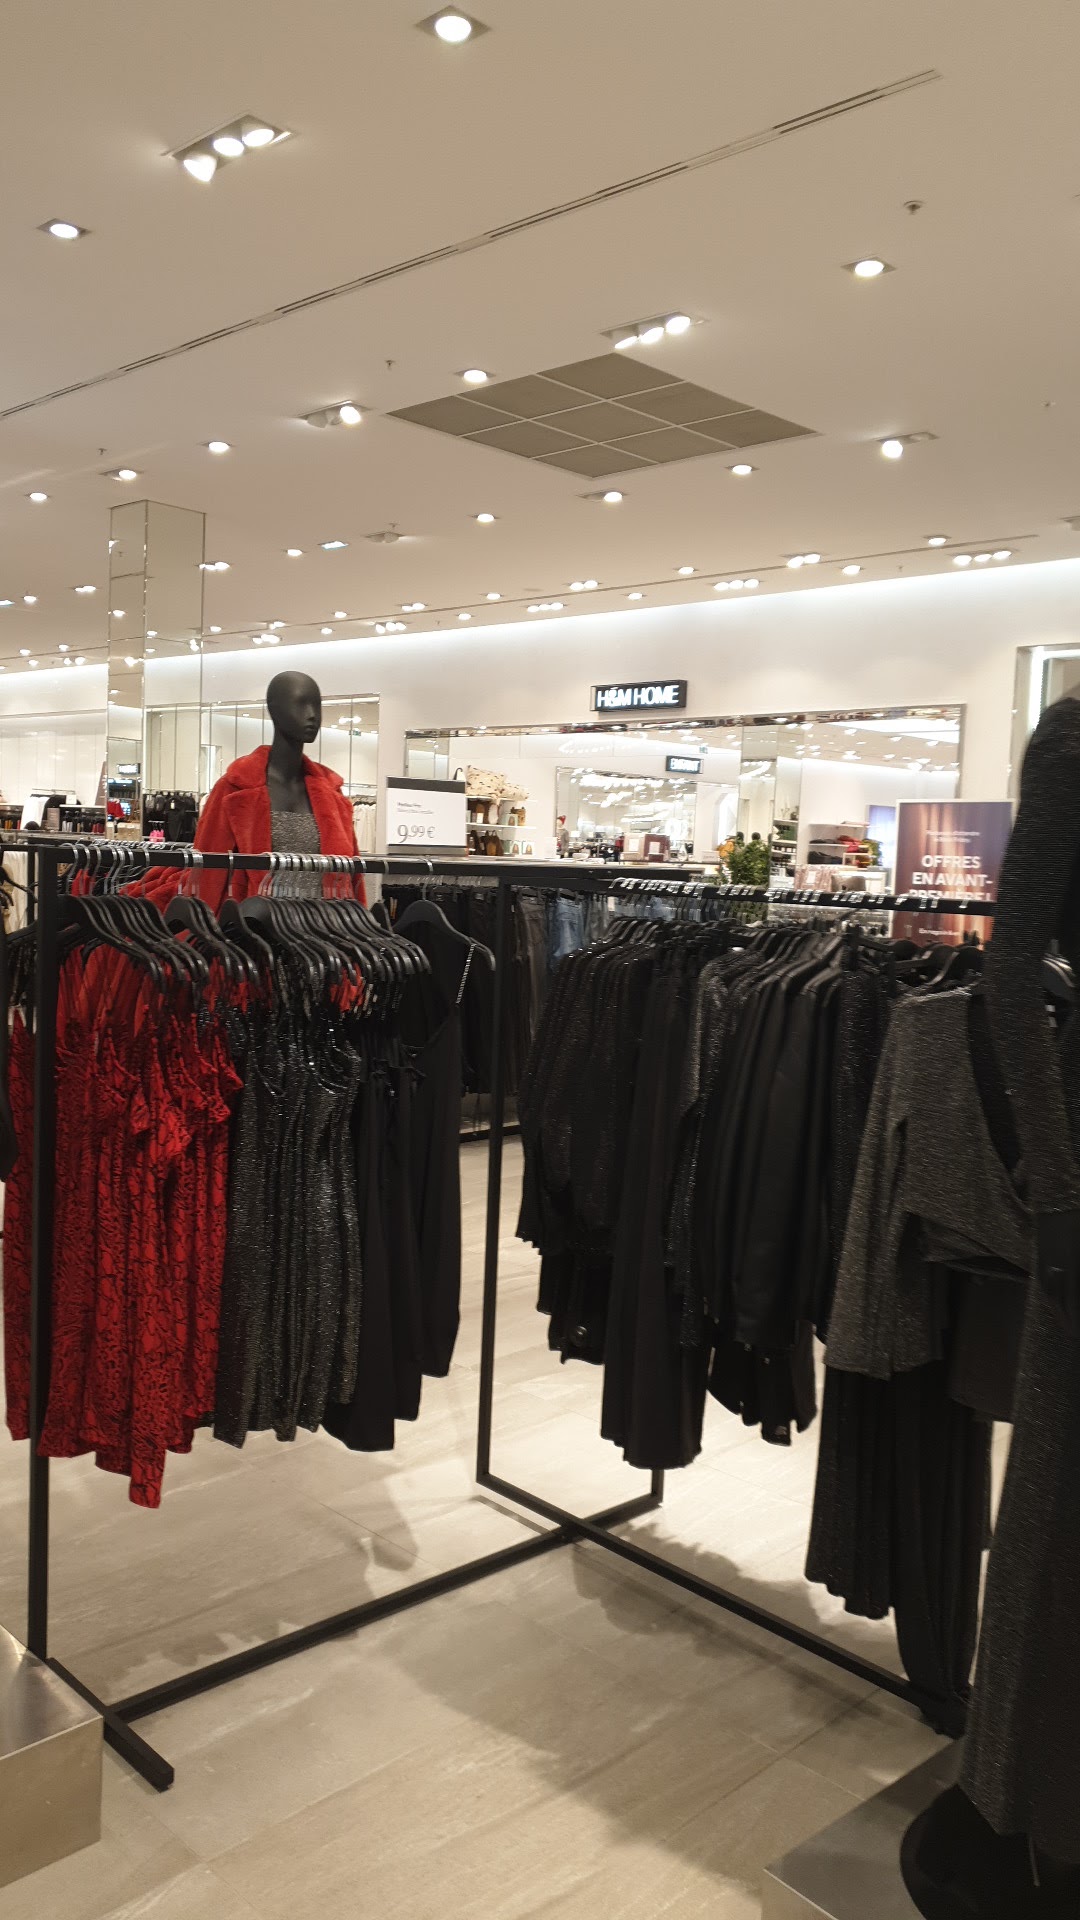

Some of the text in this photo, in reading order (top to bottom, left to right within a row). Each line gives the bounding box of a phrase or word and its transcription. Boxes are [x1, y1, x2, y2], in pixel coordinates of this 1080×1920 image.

[597, 685, 680, 707] H&M HOME
[921, 855, 981, 869] OFFRES
[912, 872, 994, 887] EN AVANT-
